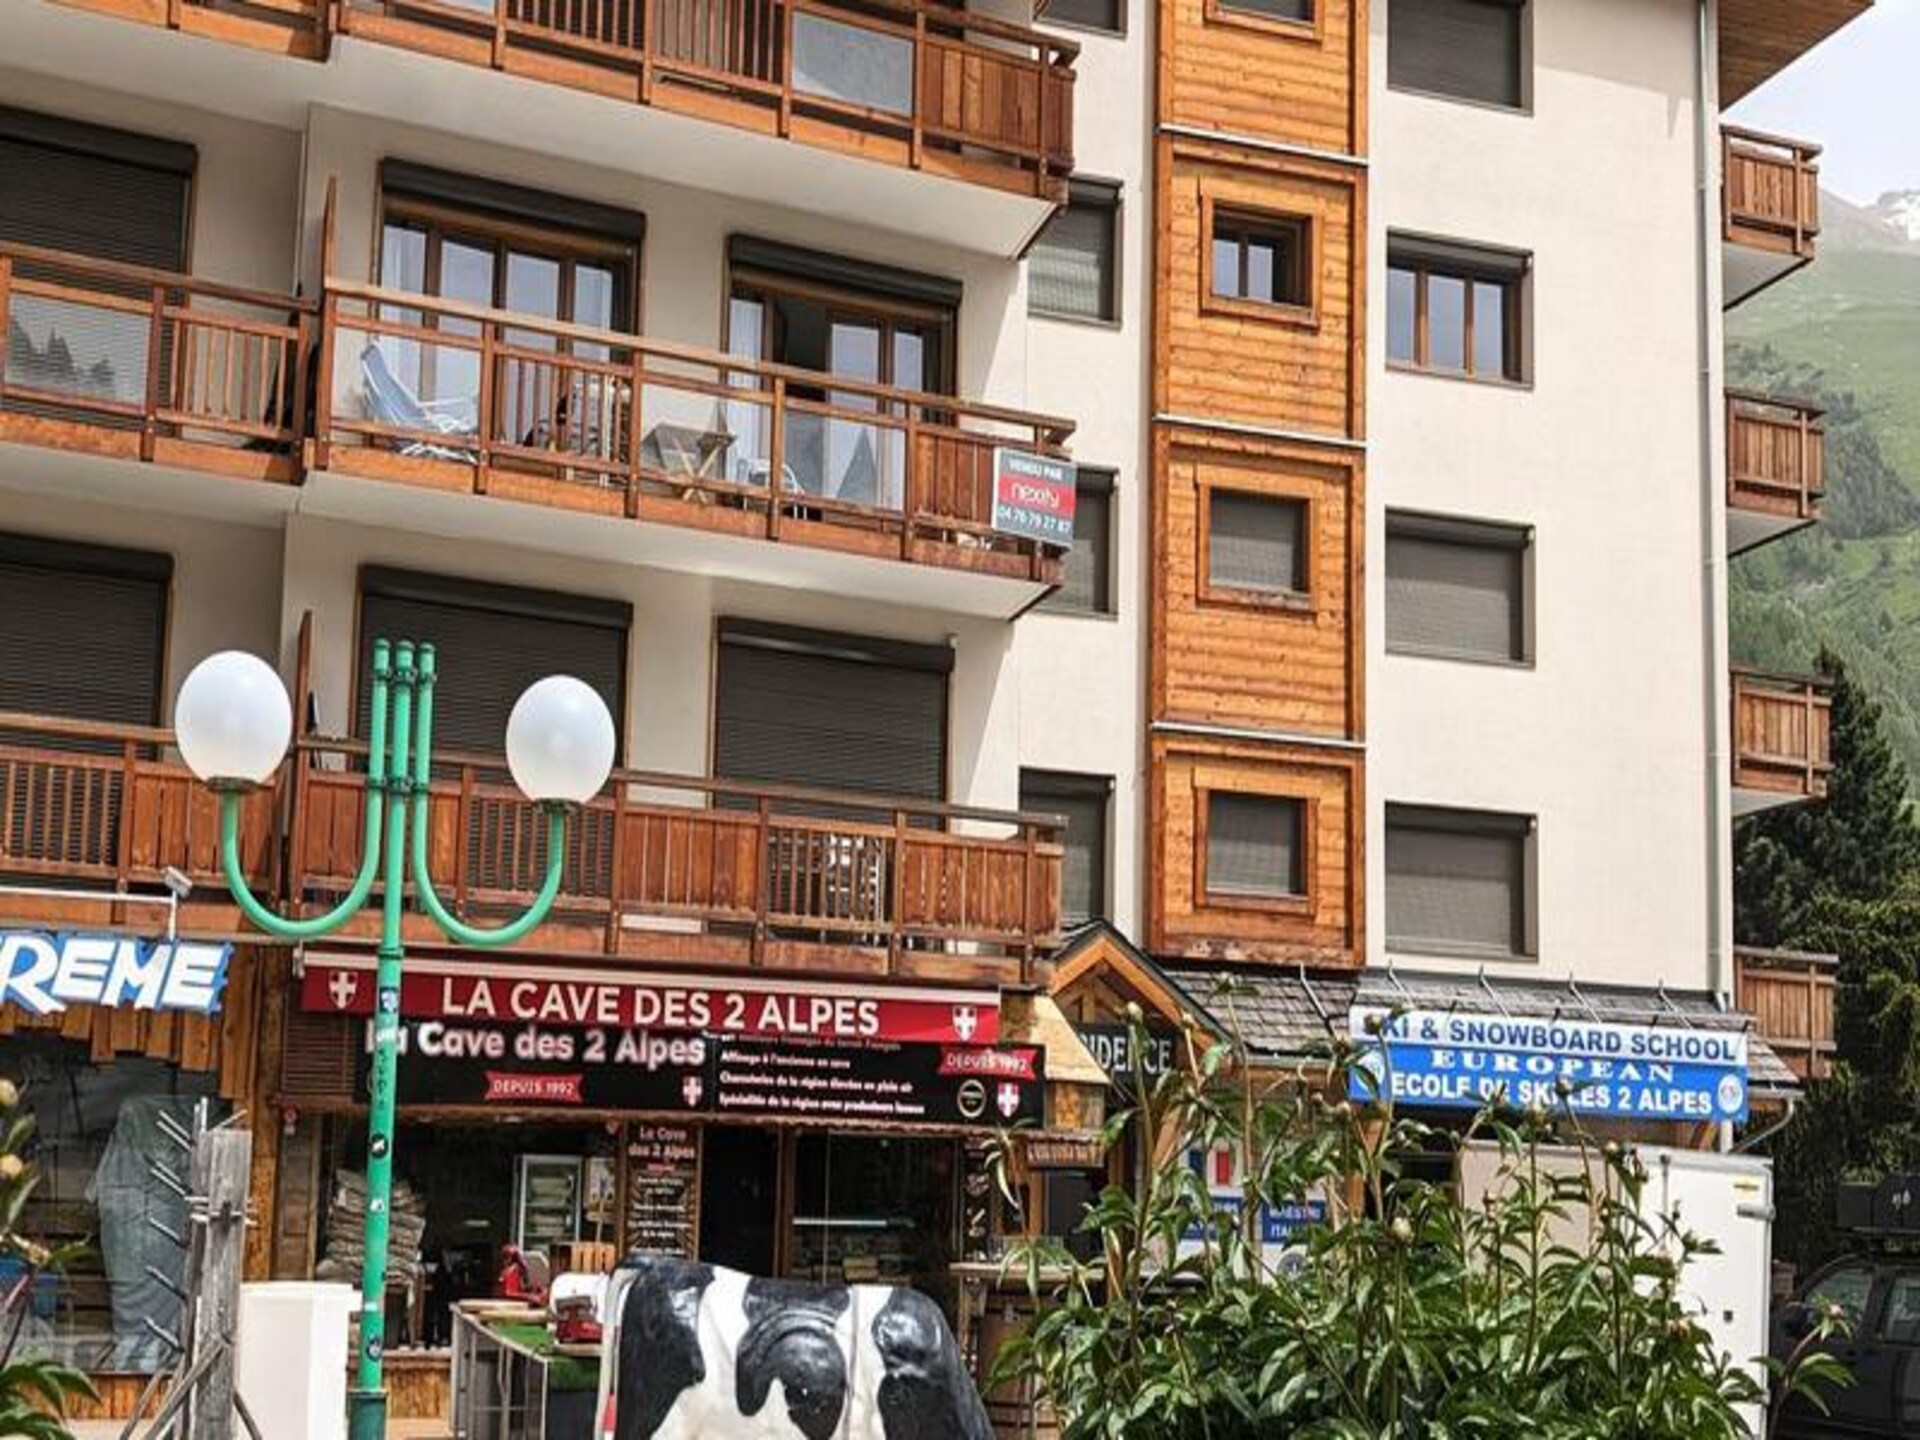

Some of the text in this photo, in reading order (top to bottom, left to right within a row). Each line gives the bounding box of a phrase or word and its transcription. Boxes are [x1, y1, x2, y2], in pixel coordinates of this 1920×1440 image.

[0, 934, 225, 1013] REME
[443, 978, 879, 1035] LA CAVE DES 2 ALPES
[418, 1021, 504, 1059] Cave
[515, 1025, 575, 1060] des
[583, 1030, 606, 1062] 2
[614, 1029, 706, 1071] Alpes
[1376, 1016, 1736, 1061] KI & SNOWBOARD SCHOOL
[493, 1079, 575, 1098] DEPUIS 1992
[1432, 1050, 1674, 1083] EUROPEAN
[1391, 1072, 1470, 1098] ECOLE
[1618, 1086, 1632, 1110] 2
[1638, 1089, 1713, 1115] ALPES
